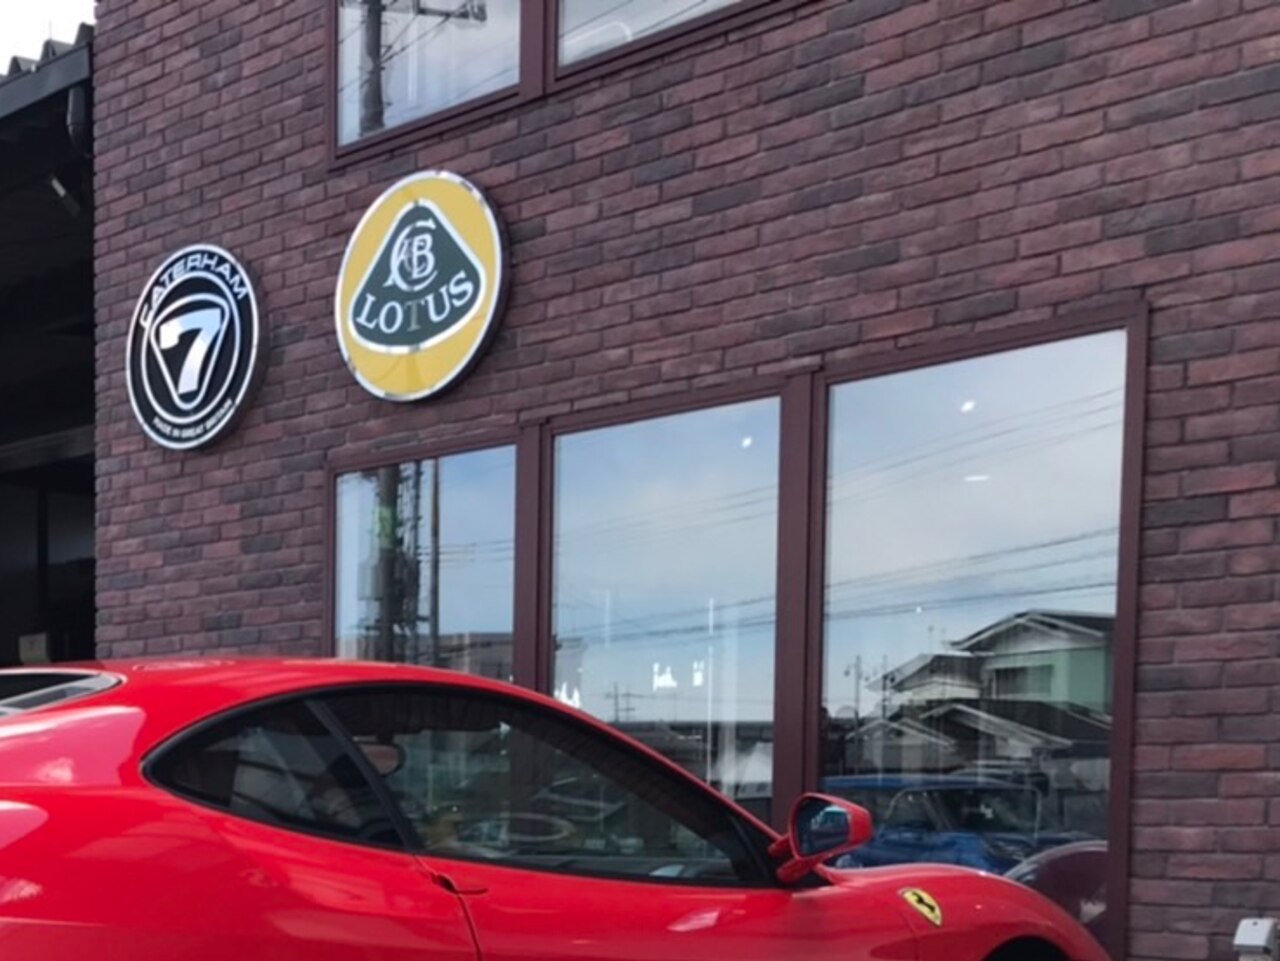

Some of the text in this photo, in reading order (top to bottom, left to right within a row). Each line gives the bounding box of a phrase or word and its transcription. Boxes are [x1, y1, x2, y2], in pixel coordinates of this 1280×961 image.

[140, 253, 249, 329] CATERHAM
[356, 269, 474, 334] LOTUS
[160, 307, 221, 394] 7
